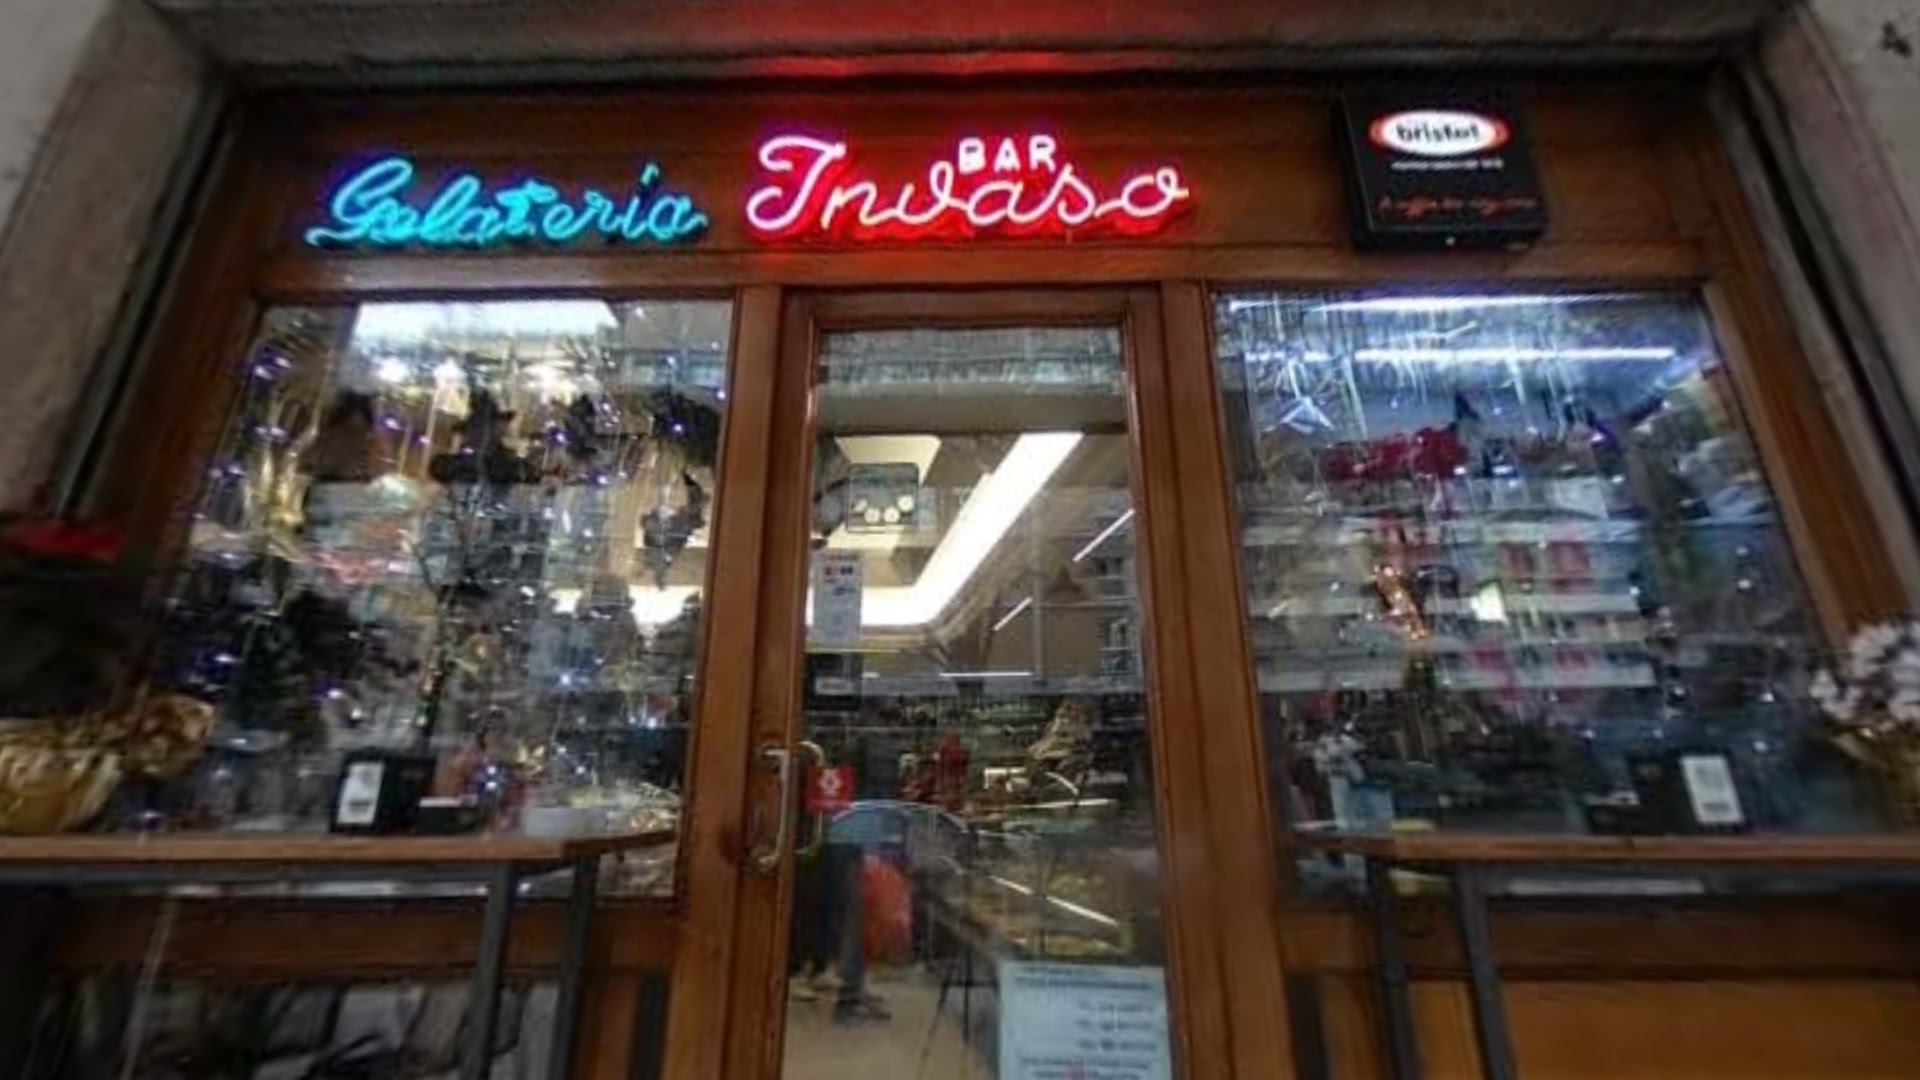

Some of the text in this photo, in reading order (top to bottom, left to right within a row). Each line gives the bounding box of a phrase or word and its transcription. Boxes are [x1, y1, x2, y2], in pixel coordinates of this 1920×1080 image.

[957, 134, 1058, 174] BAR
[1395, 122, 1480, 143] bristot
[304, 156, 710, 247] Gelateria
[746, 134, 1190, 232] Invaso
